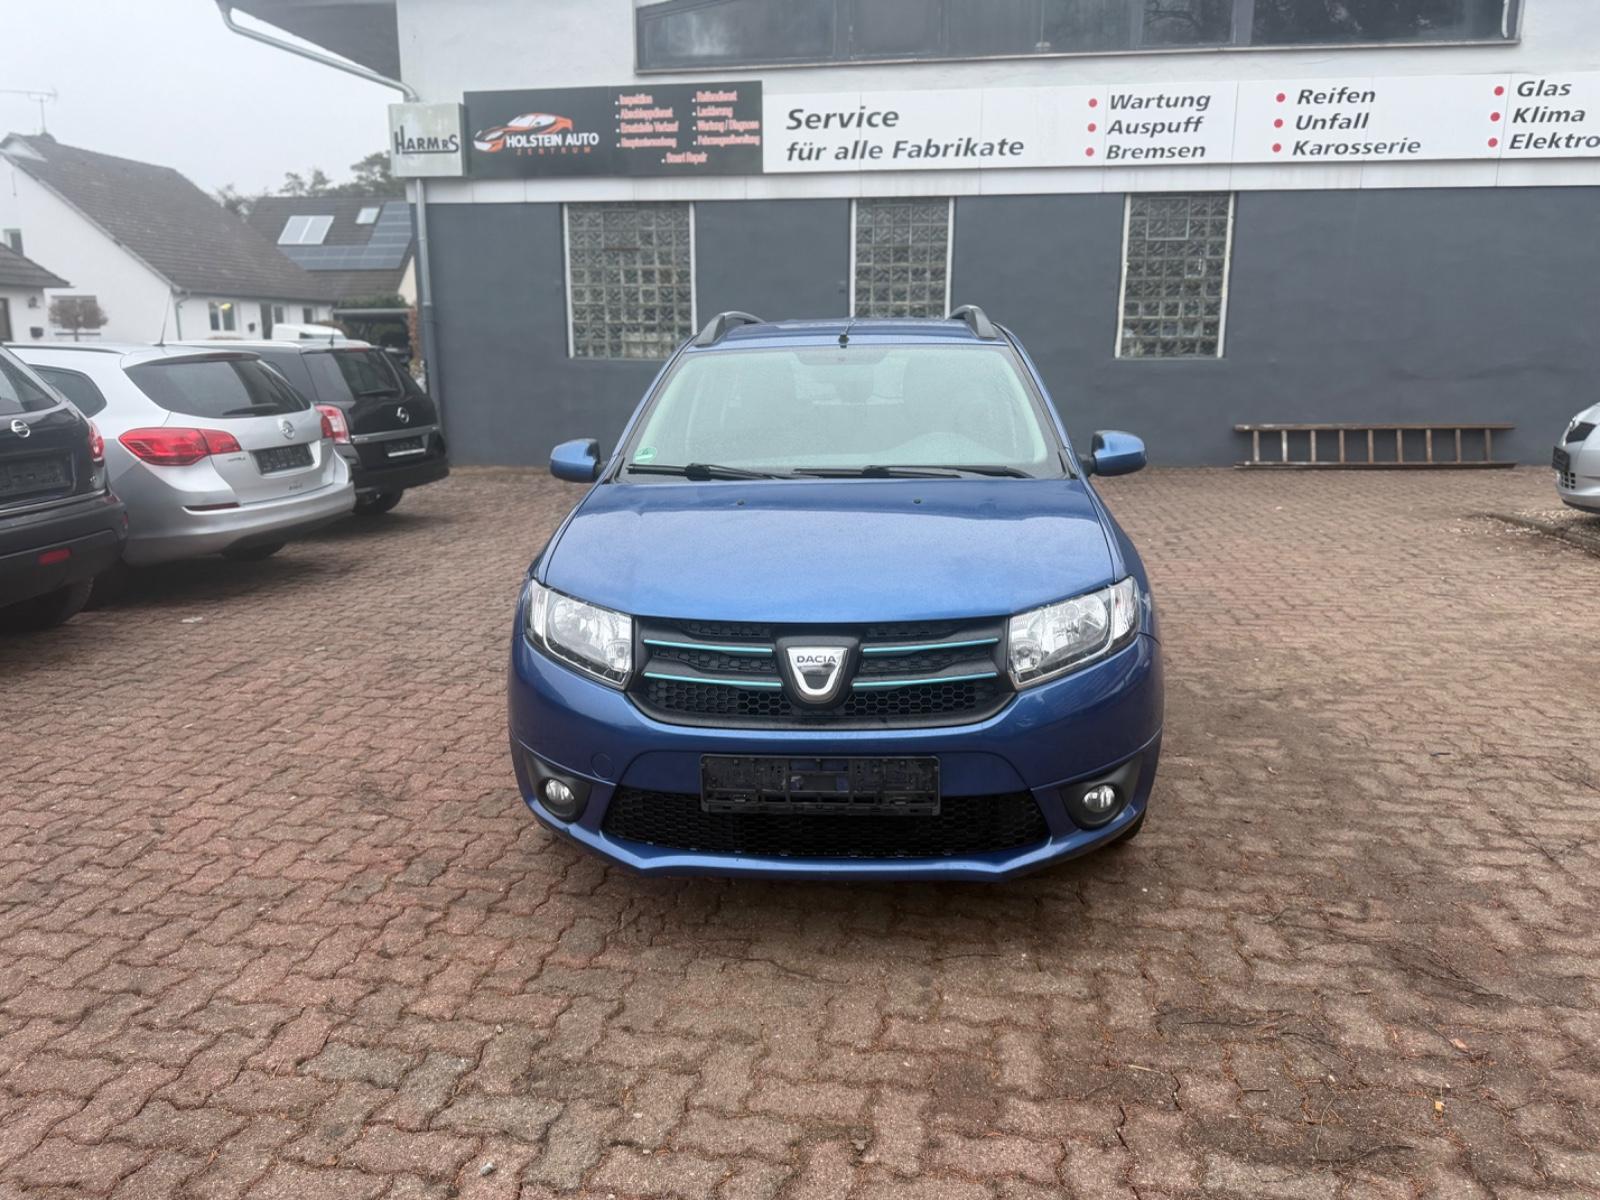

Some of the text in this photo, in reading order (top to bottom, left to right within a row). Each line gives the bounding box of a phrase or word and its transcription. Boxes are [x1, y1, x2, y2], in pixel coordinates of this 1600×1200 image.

[1297, 86, 1376, 105] Reifen
[1517, 79, 1572, 98] Glas
[1110, 94, 1211, 112] Wartung
[786, 105, 900, 131] Service
[1295, 112, 1370, 131] Unfall
[1512, 106, 1586, 124] Klima
[1107, 116, 1204, 138] Auspuff
[506, 132, 600, 148] HOLSTEIN AUTO
[786, 137, 1025, 162] für alle Fabrikate
[1292, 137, 1422, 156] Karosserie
[1106, 144, 1206, 160] Bremsen
[797, 655, 837, 663] DACIA
